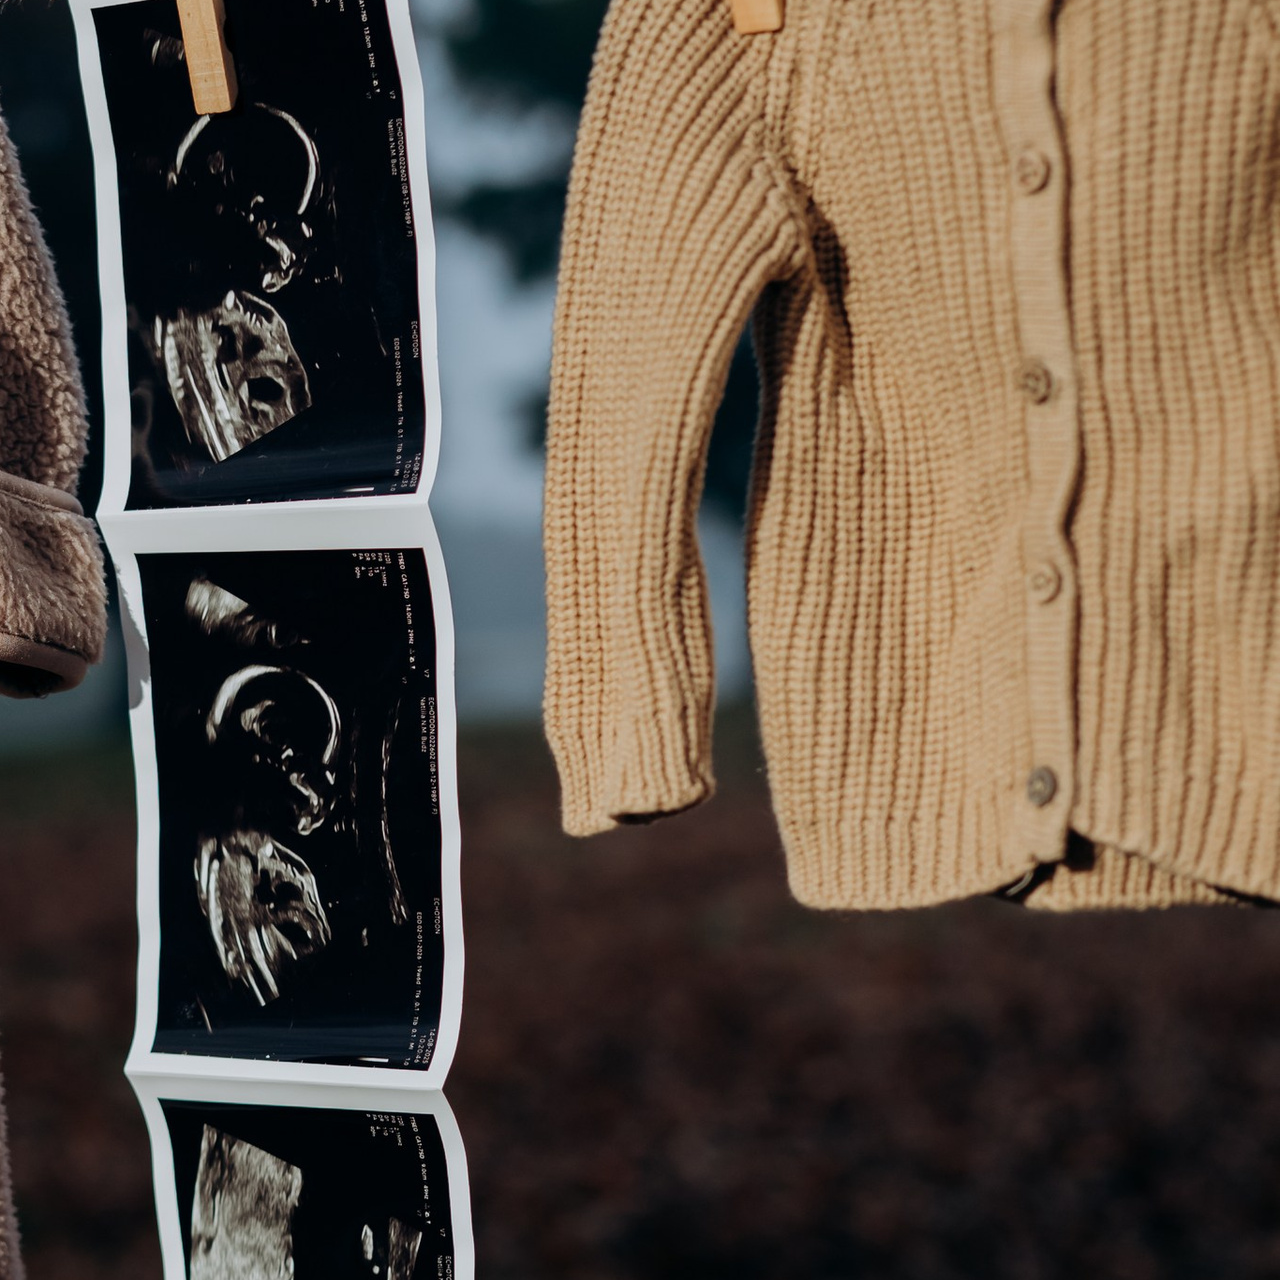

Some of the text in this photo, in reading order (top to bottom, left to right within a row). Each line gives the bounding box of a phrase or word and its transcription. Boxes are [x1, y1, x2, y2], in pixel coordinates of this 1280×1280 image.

[363, 27, 372, 48] 13.0cm
[411, 321, 419, 358] ECHOTOON
[409, 452, 421, 488] 14-08-2025
[405, 604, 413, 625] 14.0cm
[422, 1028, 436, 1064] 14-08-2025
